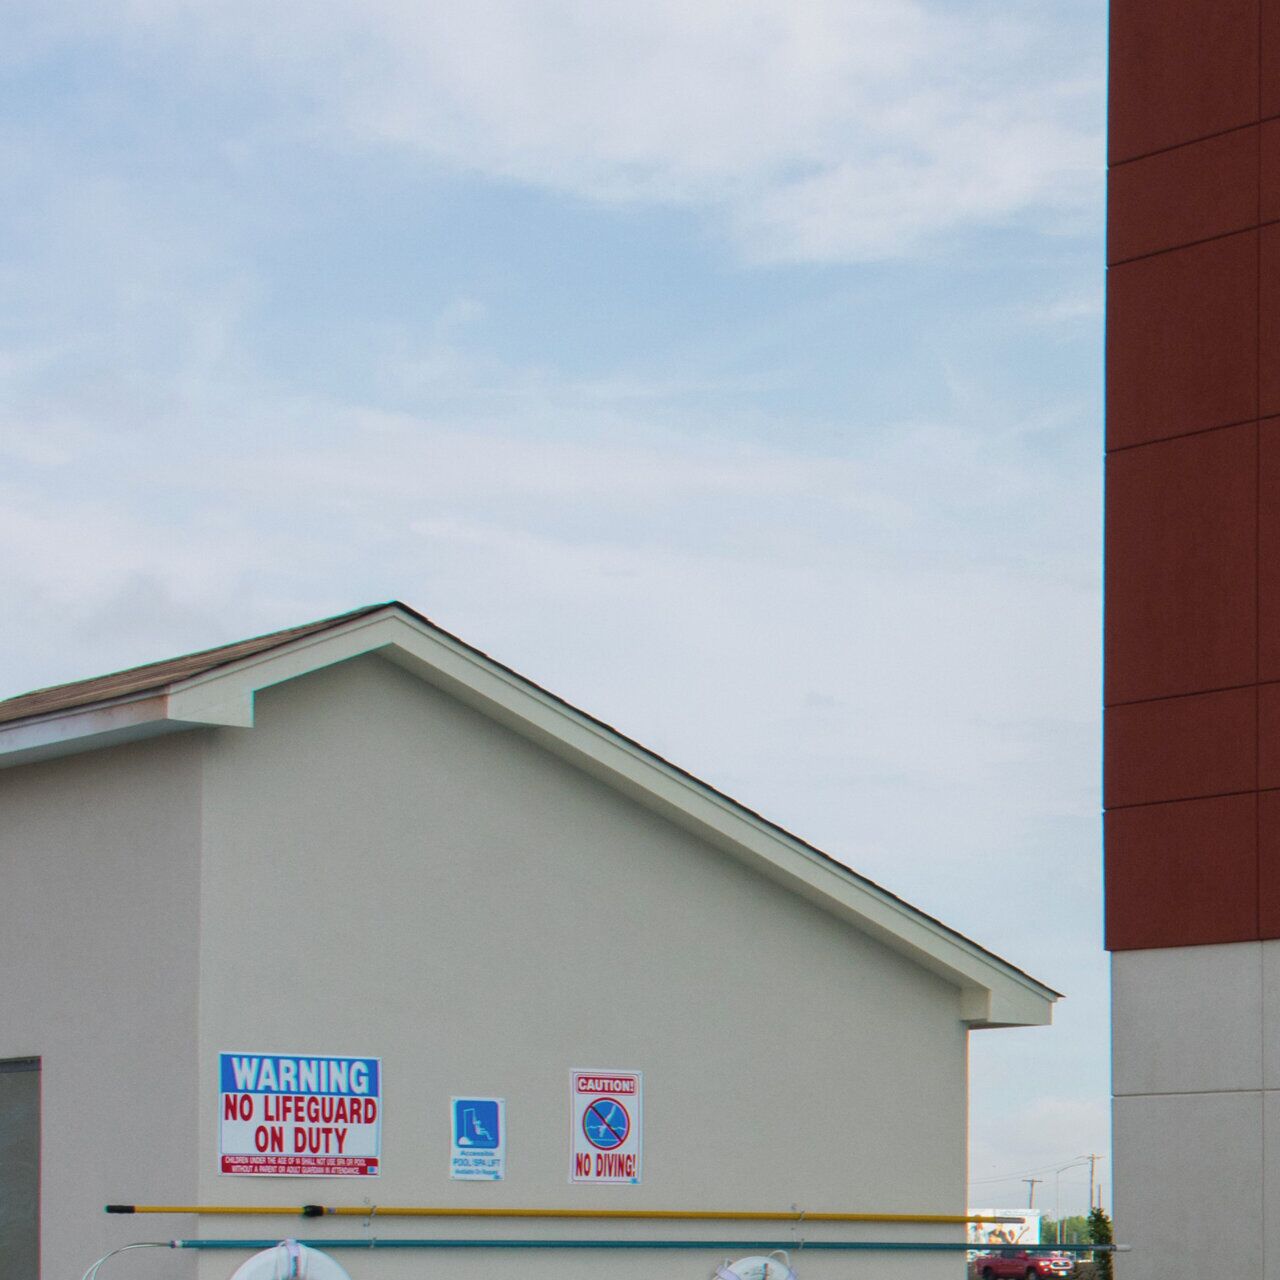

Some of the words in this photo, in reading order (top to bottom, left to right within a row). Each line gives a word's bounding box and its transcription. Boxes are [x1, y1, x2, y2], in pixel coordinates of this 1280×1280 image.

[231, 1057, 369, 1094] WARNING
[578, 1078, 634, 1092] CAUTION!
[224, 1094, 254, 1121] NO
[264, 1095, 377, 1124] LIFEGUARD
[255, 1125, 284, 1153] ON
[294, 1126, 348, 1153] DUTY
[225, 1156, 249, 1164] CHILDREN
[249, 1156, 266, 1164] UNDER
[231, 1165, 253, 1173] WITHOUT
[576, 1153, 592, 1177] NO
[596, 1154, 636, 1177] DIVING!
